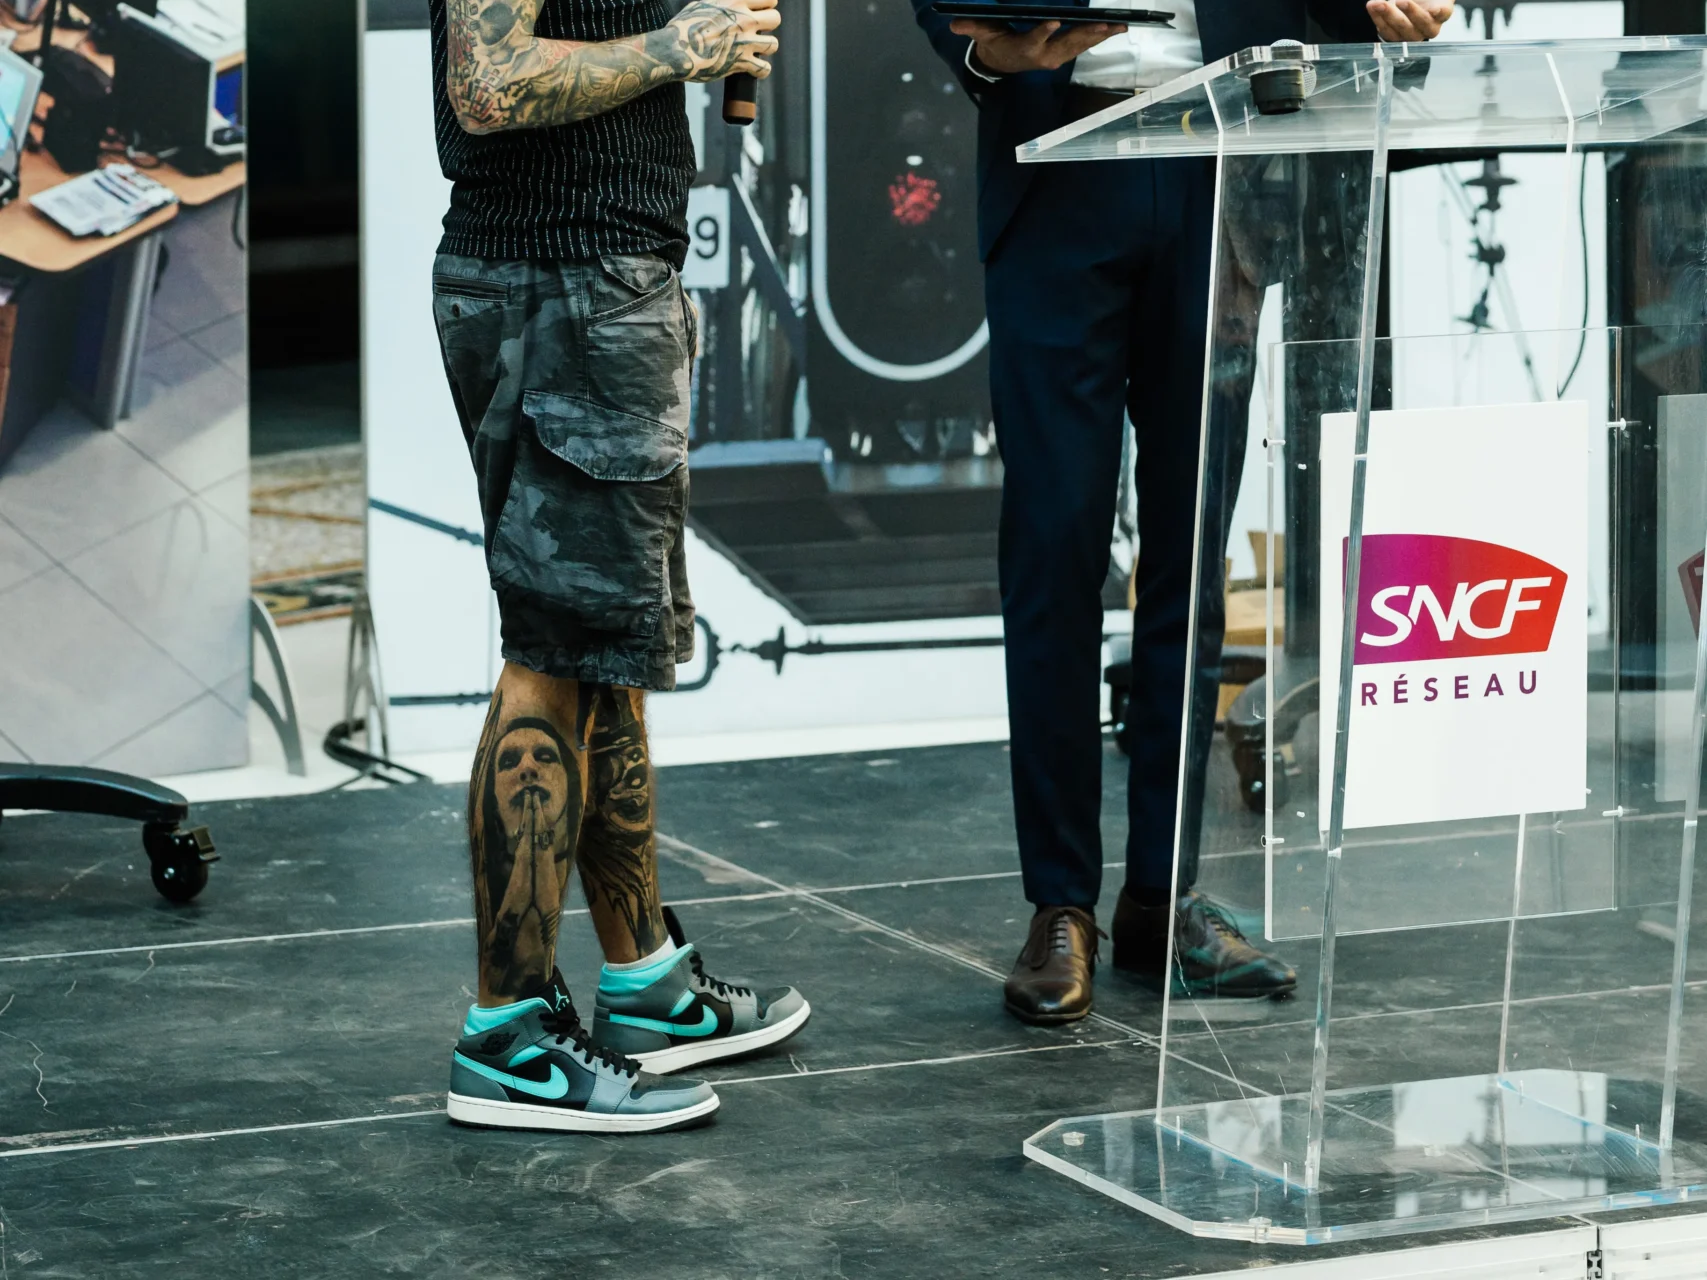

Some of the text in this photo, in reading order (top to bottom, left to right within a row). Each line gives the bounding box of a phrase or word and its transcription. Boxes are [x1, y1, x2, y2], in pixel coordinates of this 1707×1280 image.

[695, 216, 720, 260] 9
[1359, 576, 1552, 648] SNCF
[1361, 670, 1537, 707] RÉSEAU
